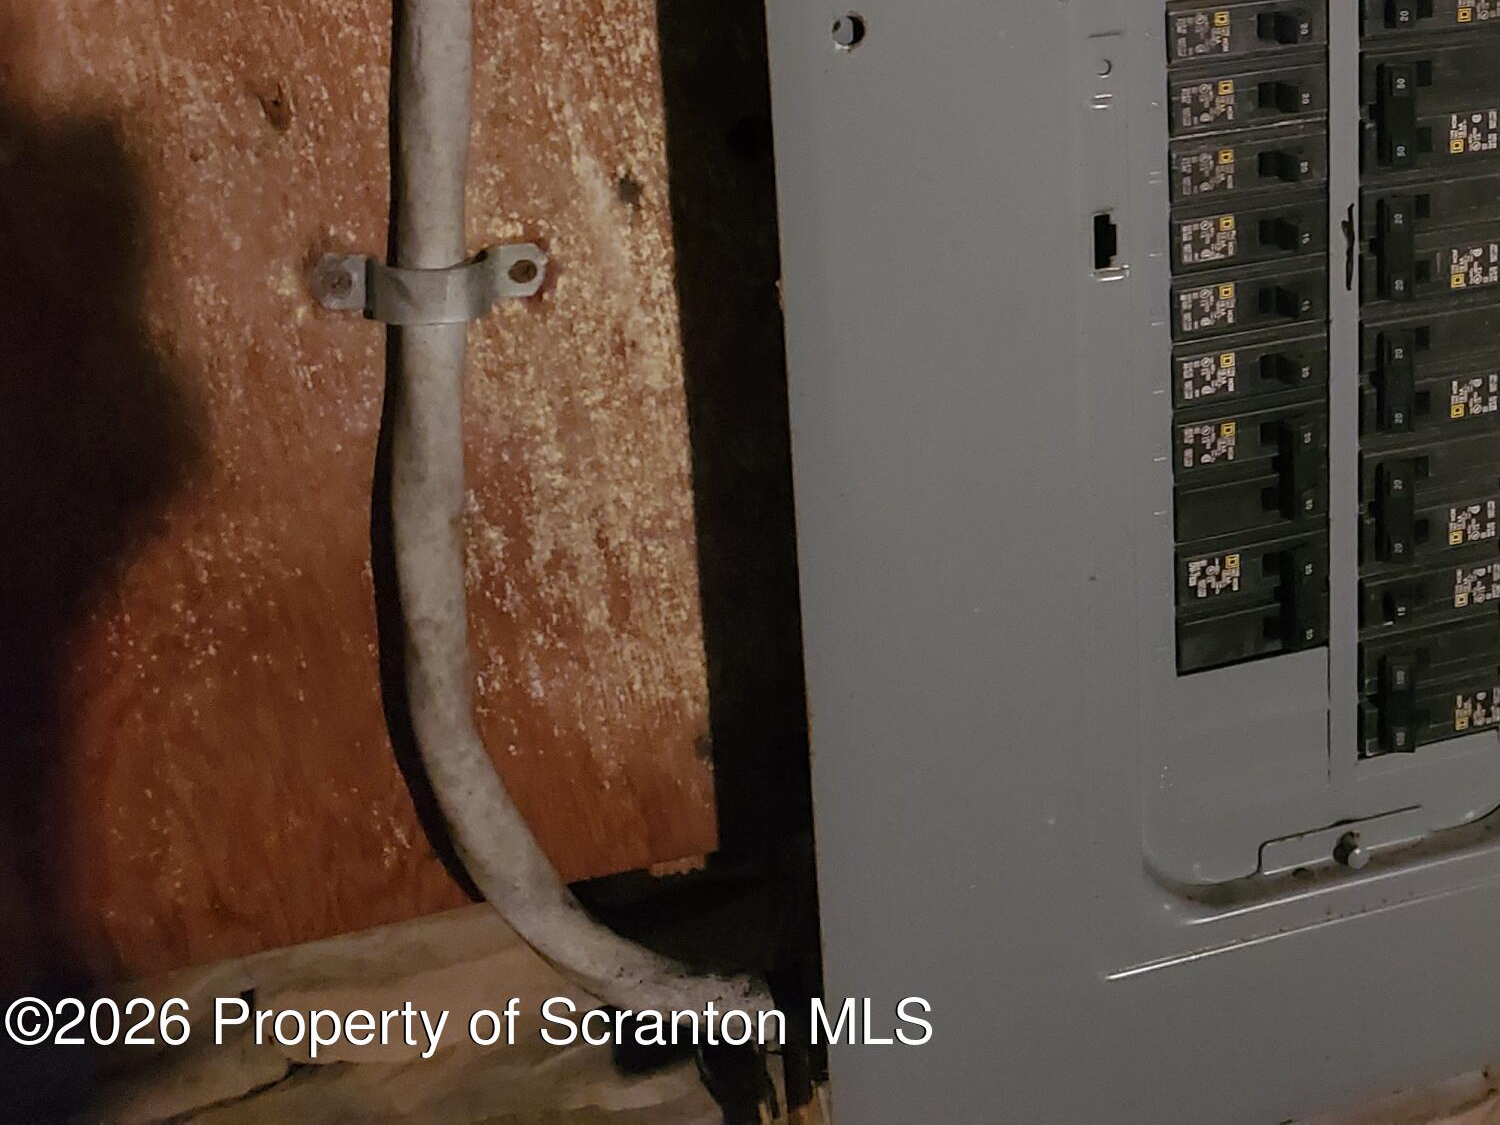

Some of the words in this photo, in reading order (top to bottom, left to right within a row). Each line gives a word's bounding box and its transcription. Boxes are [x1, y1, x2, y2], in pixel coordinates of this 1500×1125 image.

[1400, 11, 1409, 21] 20
[1300, 23, 1308, 35] 20
[1302, 93, 1310, 105] 20
[1300, 162, 1308, 173] 20
[1394, 214, 1403, 224] 20
[1395, 280, 1404, 291] 20
[1395, 349, 1403, 359] 20
[1302, 367, 1309, 378] 20
[1395, 413, 1403, 423] 20
[1394, 543, 1403, 553] 20
